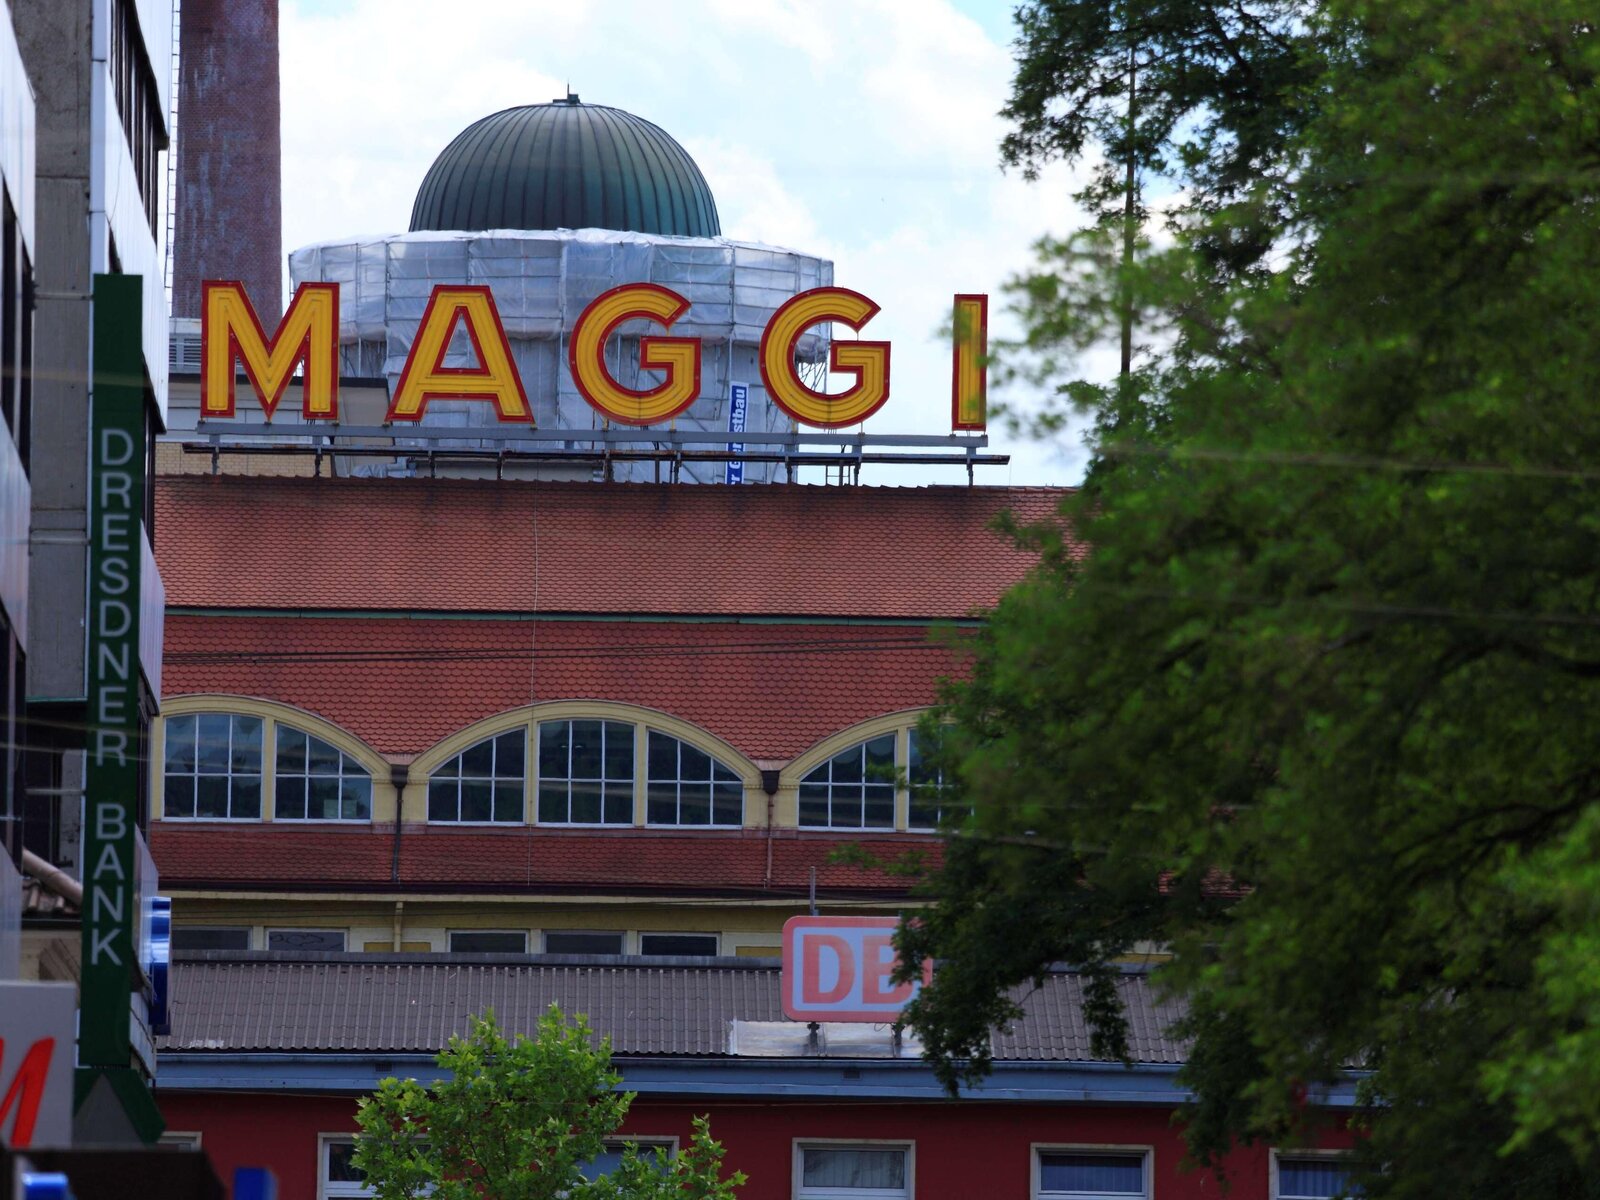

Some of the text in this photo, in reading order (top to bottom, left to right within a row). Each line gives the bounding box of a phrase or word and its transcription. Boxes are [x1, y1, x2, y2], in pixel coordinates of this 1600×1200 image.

[202, 279, 988, 431] MAGGI
[96, 428, 134, 767] DRESDNER
[91, 803, 127, 966] BANK
[802, 934, 915, 1004] DB
